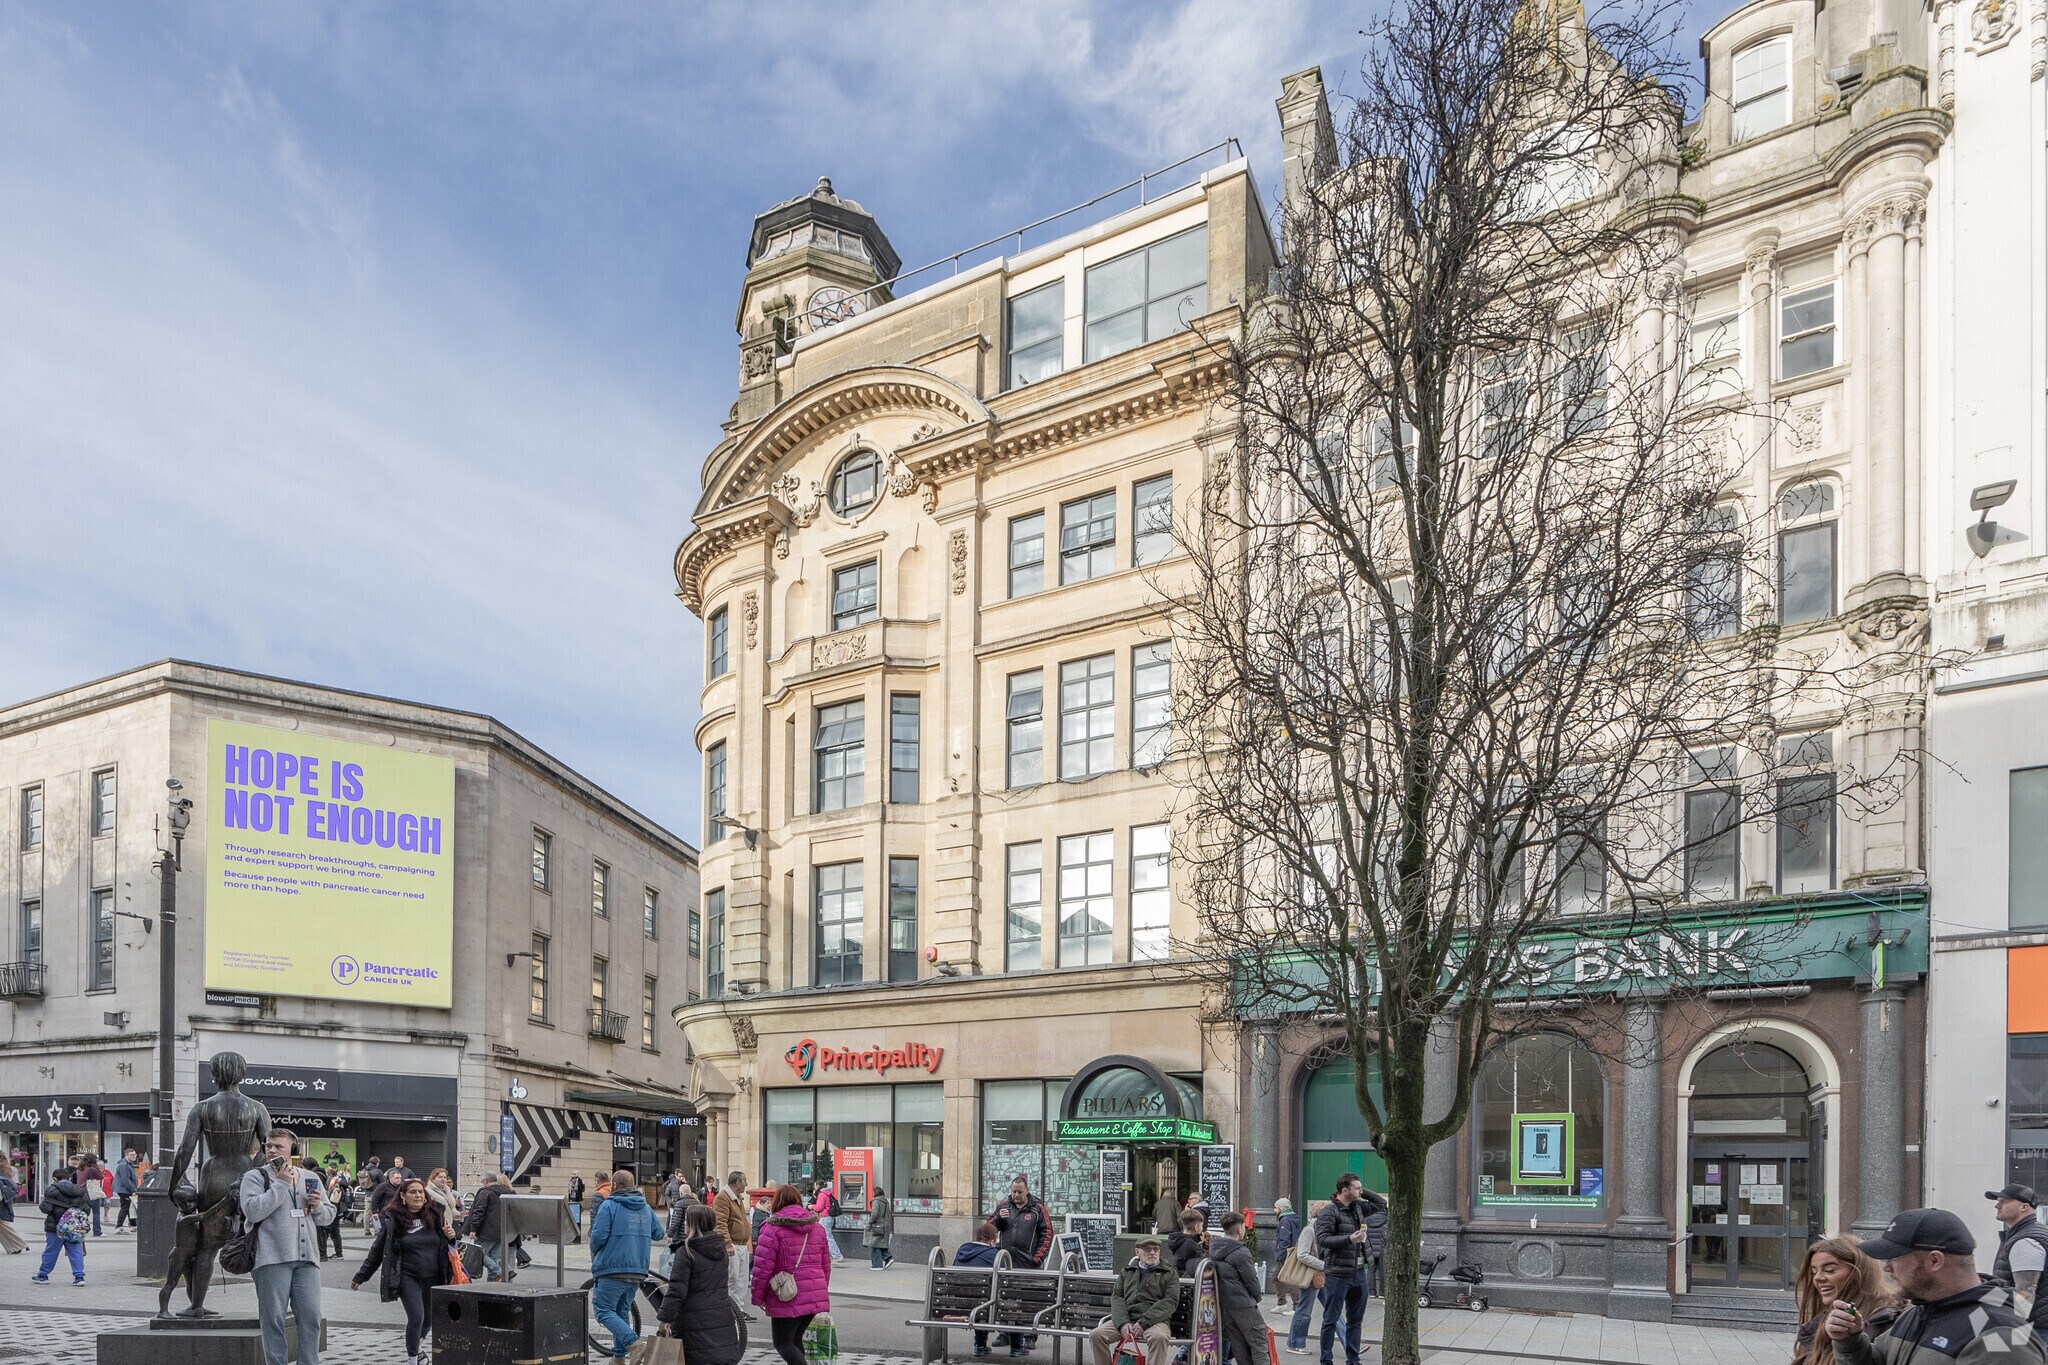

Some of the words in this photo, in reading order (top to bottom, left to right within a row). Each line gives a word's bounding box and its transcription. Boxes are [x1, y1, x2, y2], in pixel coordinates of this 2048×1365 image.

[225, 743, 319, 796] HOPE
[331, 760, 364, 802] IS
[224, 788, 295, 835] NOT
[306, 800, 441, 855] ENOUGH
[224, 843, 265, 855] Through
[267, 849, 306, 859] research
[308, 854, 377, 869] breakthroughs,
[378, 863, 435, 877] campaigning
[224, 854, 243, 862] and
[245, 856, 275, 866] expert
[277, 860, 314, 870] support
[331, 866, 355, 876] bring
[357, 871, 383, 879] more.
[224, 869, 264, 880] Because
[266, 875, 298, 885] people
[299, 879, 321, 887] with
[322, 882, 370, 893] pancreatic
[371, 888, 401, 897] cancer
[402, 891, 425, 899] need
[224, 880, 249, 889] more
[251, 883, 273, 892] than
[275, 886, 301, 895] hope.
[1574, 928, 1751, 983] BANK
[338, 961, 354, 978] P
[364, 962, 438, 979] Pancreatic
[363, 975, 398, 985] CANCER
[820, 1041, 944, 1075] Principality
[239, 1076, 308, 1091] erdrug
[1083, 1095, 1161, 1112] PILLARS
[615, 1120, 633, 1134] ROXY
[661, 1117, 677, 1127] ROXY
[678, 1117, 699, 1126] LANES
[1060, 1123, 1110, 1135] Restaurant
[1111, 1123, 1121, 1135] &
[1122, 1121, 1147, 1138] Coffee
[1150, 1120, 1173, 1138] Shop
[613, 1135, 635, 1149] LANES
[1203, 1183, 1208, 1192] 2
[1209, 1183, 1228, 1192] MEALS
